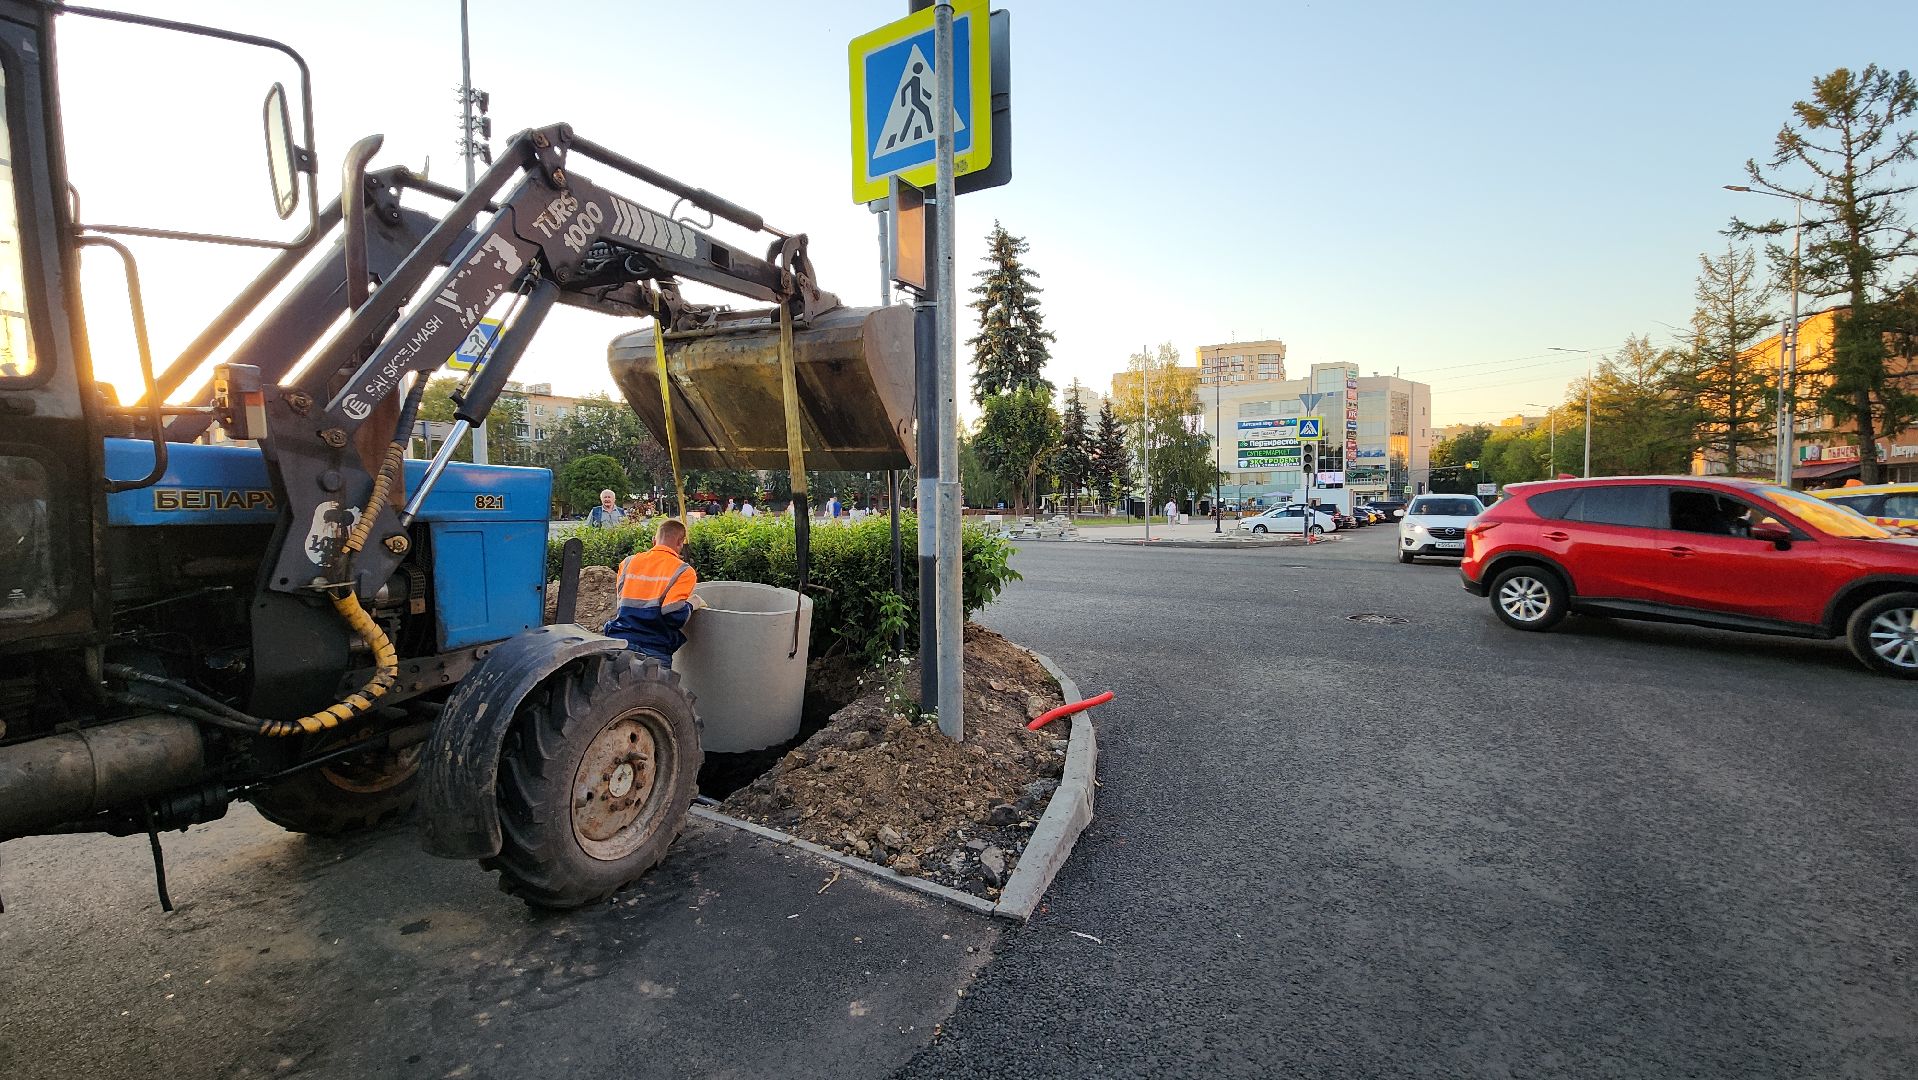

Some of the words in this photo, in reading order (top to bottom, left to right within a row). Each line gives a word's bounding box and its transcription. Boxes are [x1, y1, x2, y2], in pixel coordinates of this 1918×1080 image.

[531, 189, 578, 239] TURS
[563, 201, 603, 253] 1000
[1246, 449, 1291, 457] СУПЕРМАРКЕТ
[1249, 439, 1299, 448] Перекресток
